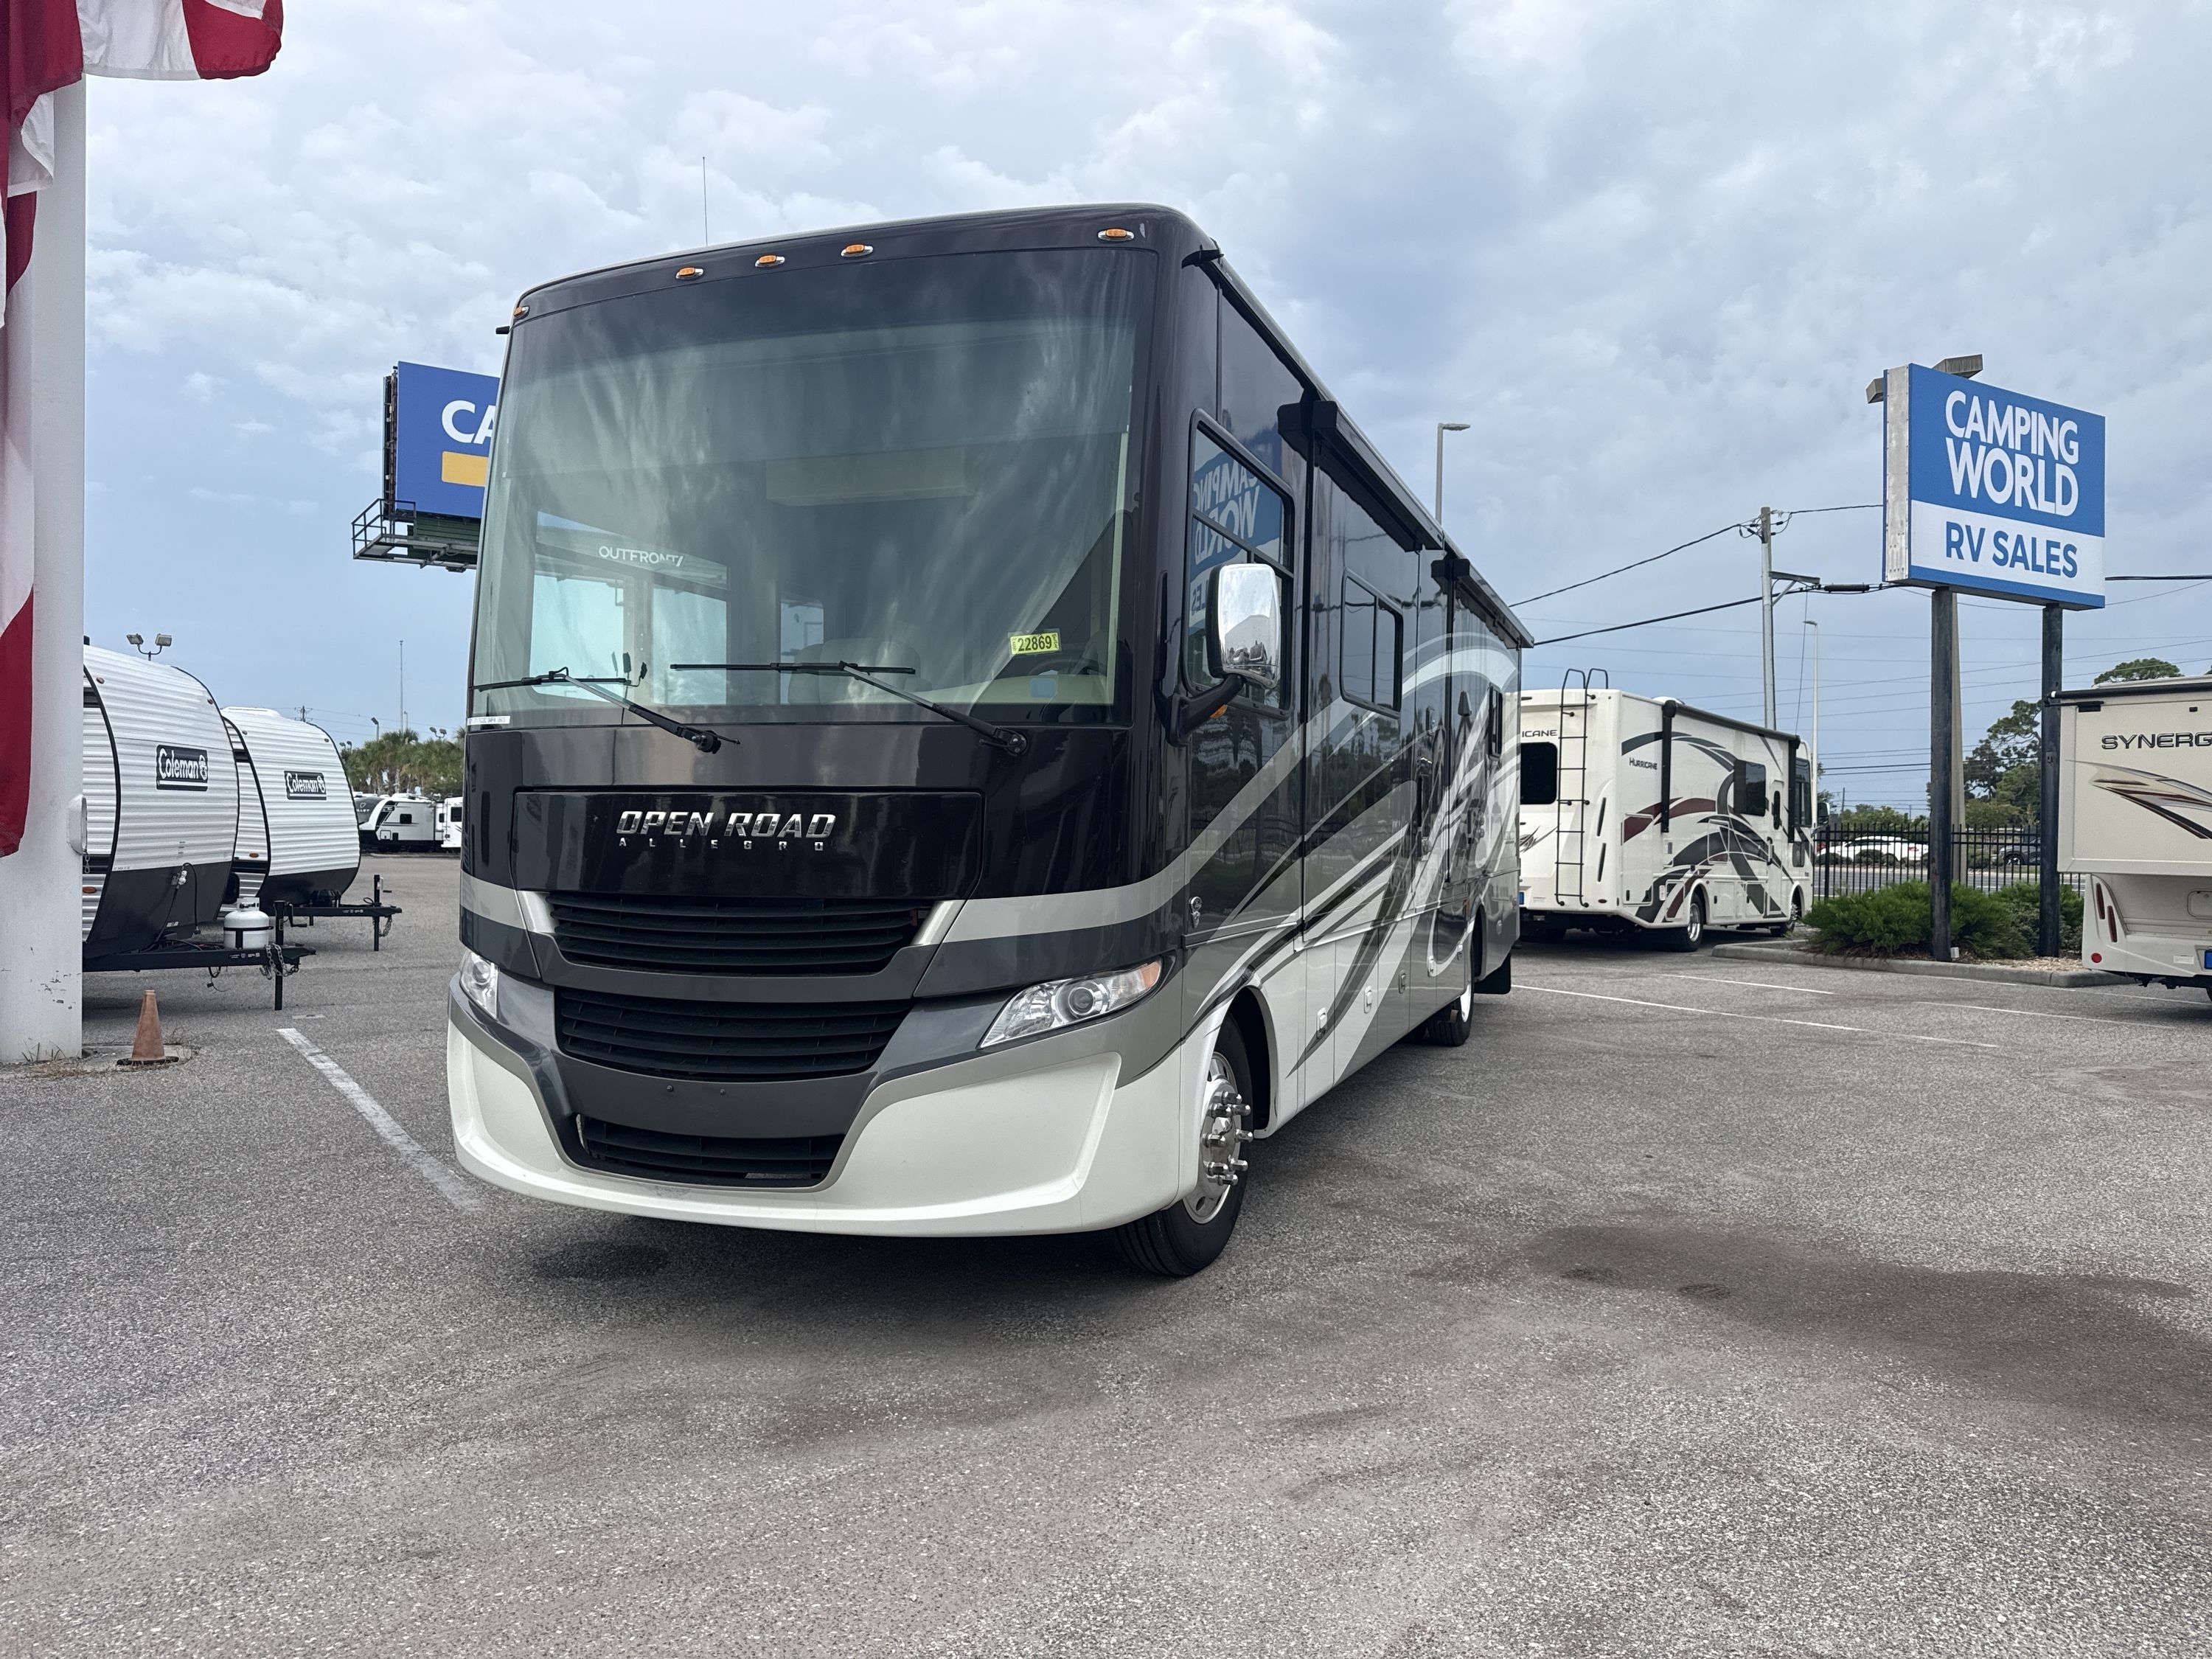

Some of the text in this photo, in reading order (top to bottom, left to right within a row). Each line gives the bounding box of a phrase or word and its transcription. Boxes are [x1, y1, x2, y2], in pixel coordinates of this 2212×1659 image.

[1945, 390, 2079, 465] CAMPING
[1945, 437, 2079, 517] WORLD
[1946, 521, 2078, 578] RV SALES
[1018, 636, 1052, 651] 22869
[2101, 731, 2212, 749] SYNERG
[159, 748, 199, 779] Coleman
[286, 773, 319, 793] Coleman
[616, 811, 836, 838] OPEN ROAD
[619, 838, 824, 851] ALLEGRO
